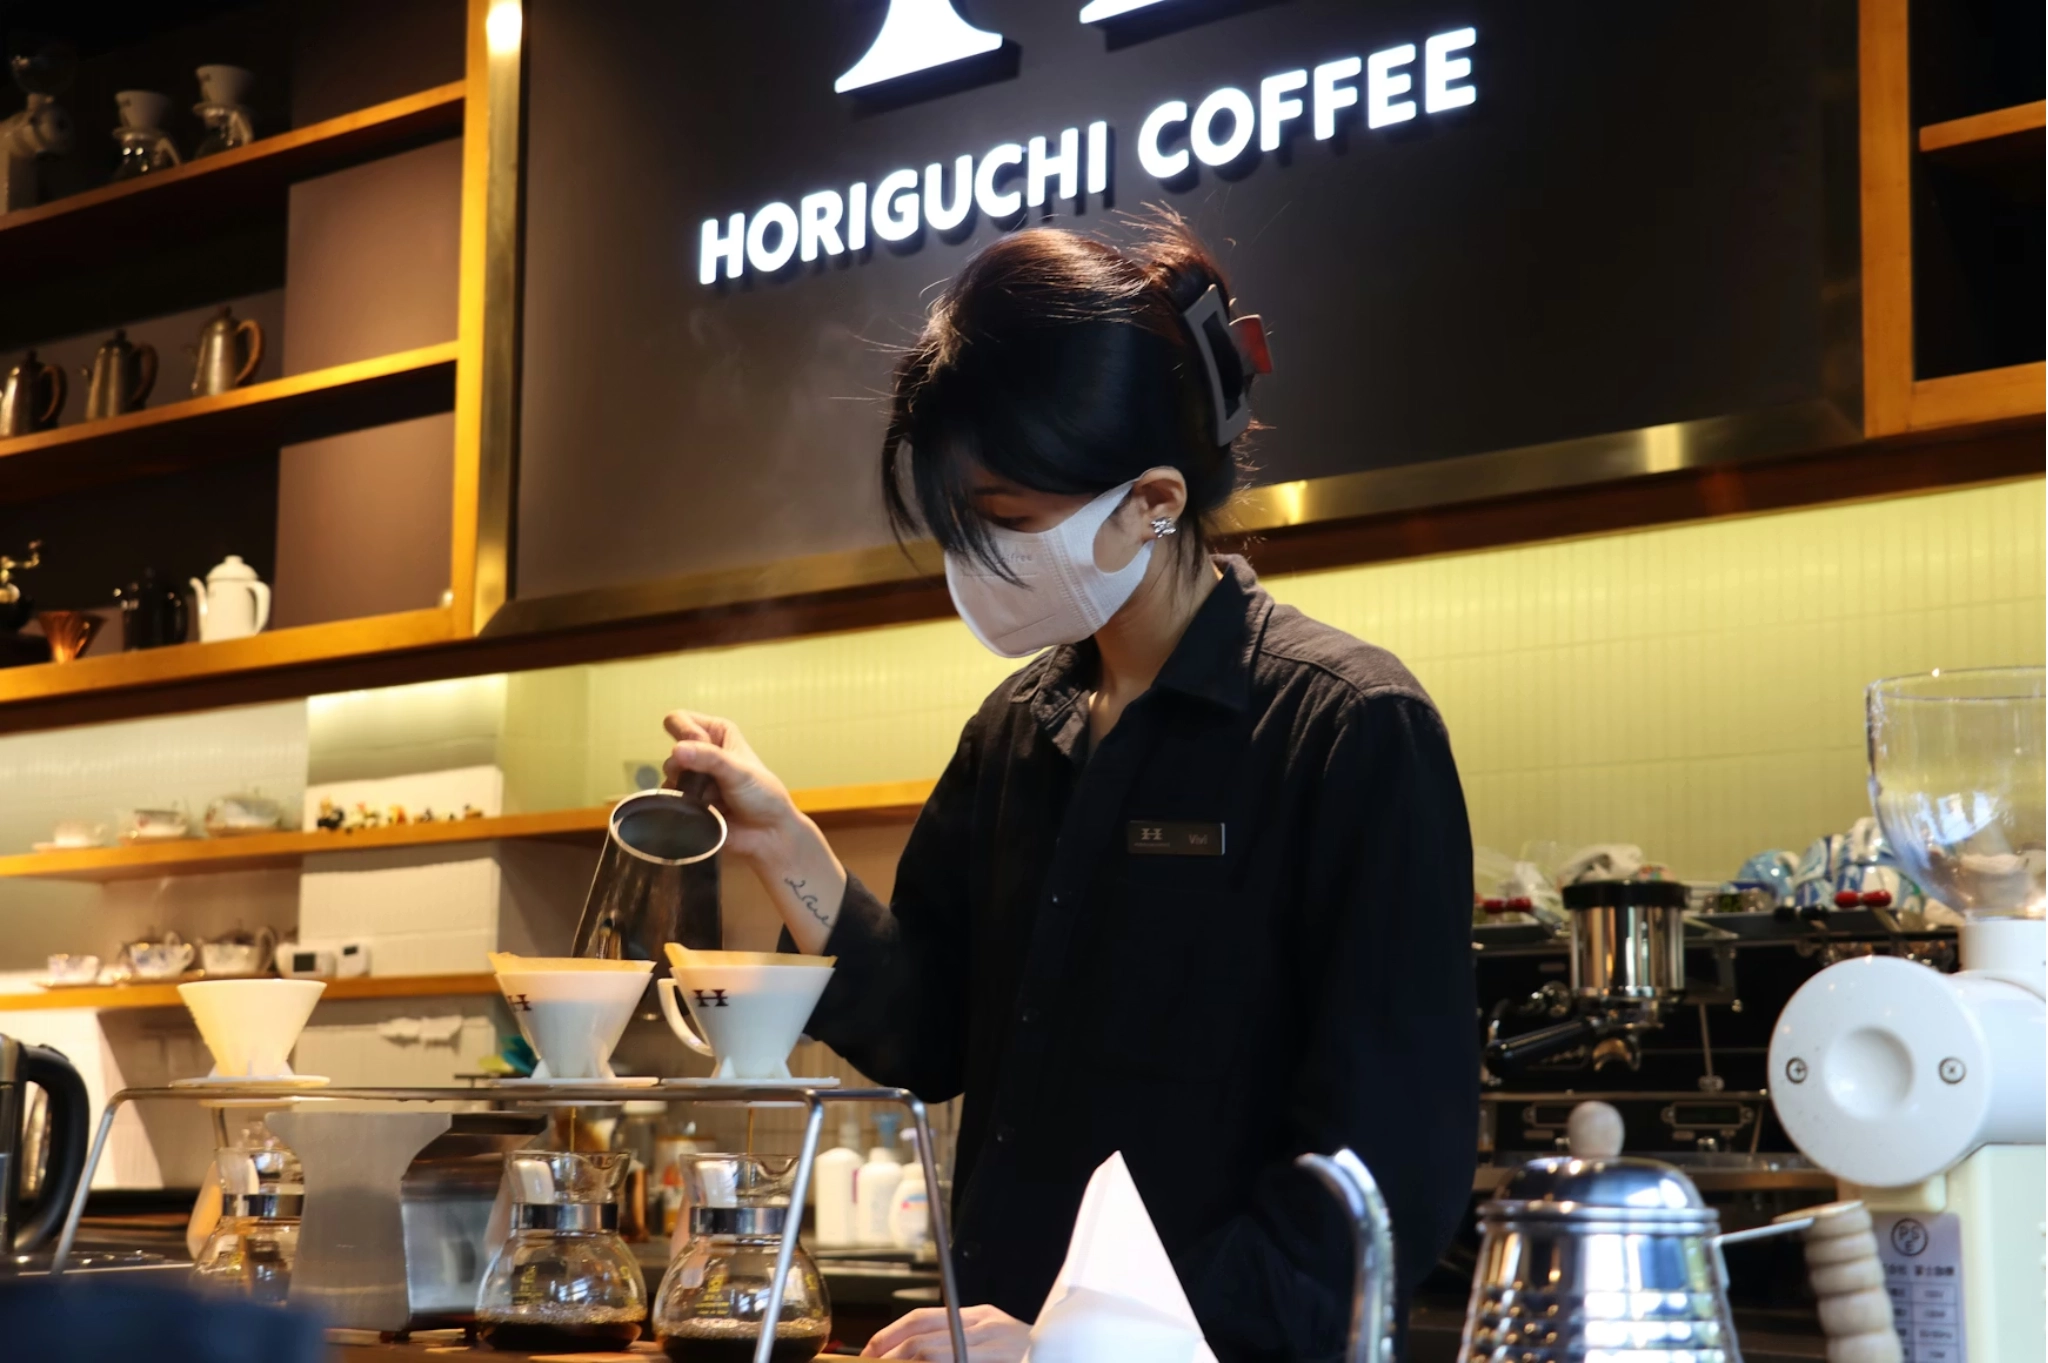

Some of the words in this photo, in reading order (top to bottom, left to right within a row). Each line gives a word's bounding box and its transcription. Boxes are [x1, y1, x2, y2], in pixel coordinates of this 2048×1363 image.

[700, 121, 1107, 284] HORIGUCHI
[1138, 27, 1476, 178] COFFEE
[692, 989, 728, 1007] H
